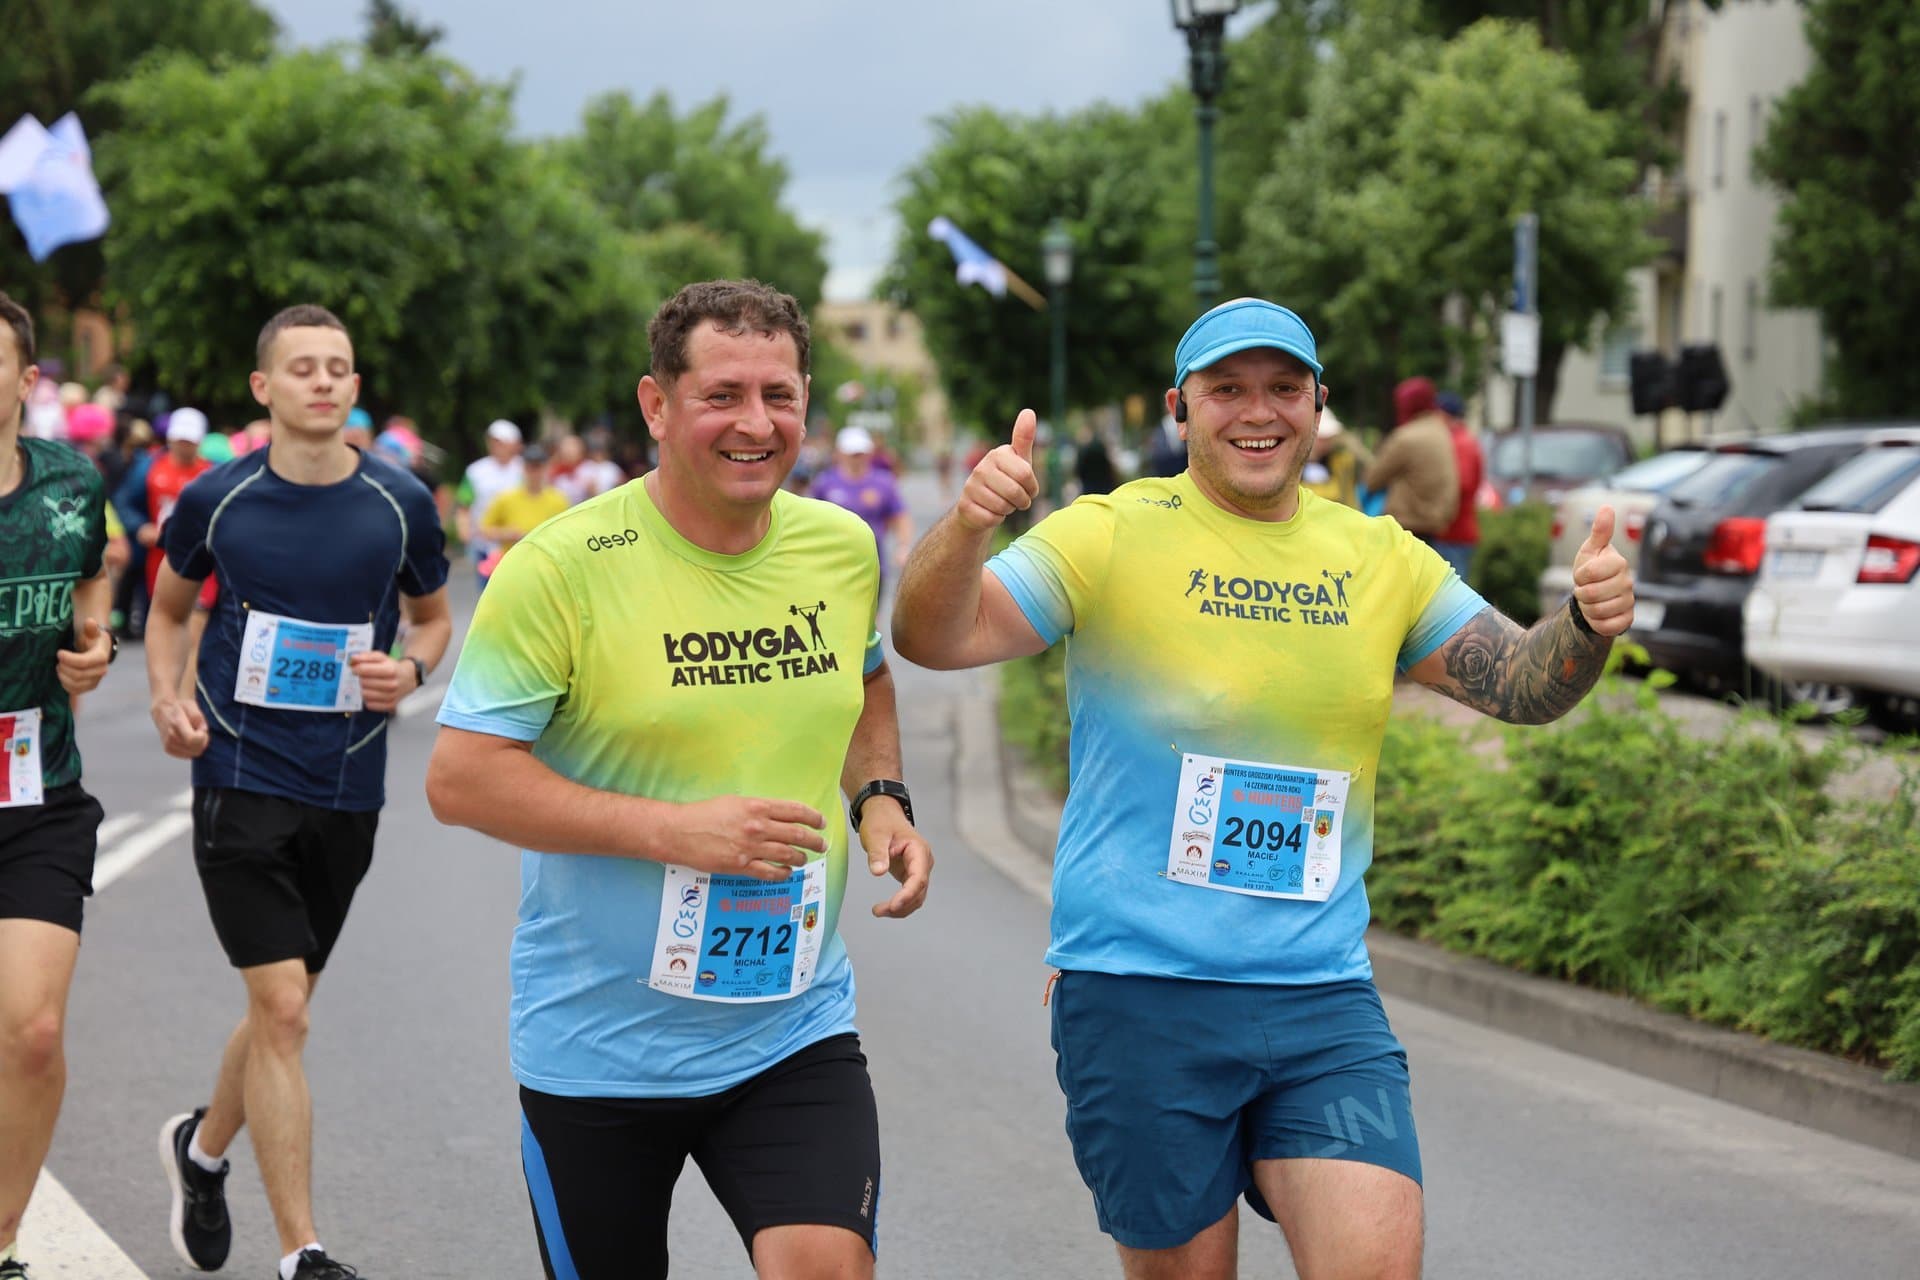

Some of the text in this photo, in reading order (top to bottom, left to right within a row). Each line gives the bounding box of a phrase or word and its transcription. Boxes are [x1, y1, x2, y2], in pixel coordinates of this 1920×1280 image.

[586, 528, 639, 552] deep
[1213, 574, 1334, 607] ŁODYGA
[1199, 600, 1349, 626] ATHLETIC TEAM
[663, 624, 808, 663] ŁODYGA
[274, 657, 337, 682] 2288
[671, 652, 840, 687] ATHLETIC TEAM
[1223, 768, 1247, 778] HUNTERS
[1251, 782, 1274, 791] CZERWCA
[1247, 789, 1303, 809] HUNTERS
[1222, 816, 1302, 854] 2094
[1247, 850, 1279, 861] MACIEJ
[1177, 867, 1207, 880] MAXIM
[735, 896, 792, 913] HUNTERS
[708, 924, 793, 957] 2712
[734, 959, 767, 968] MICHAŁ
[860, 1176, 873, 1219] ACTIVE
